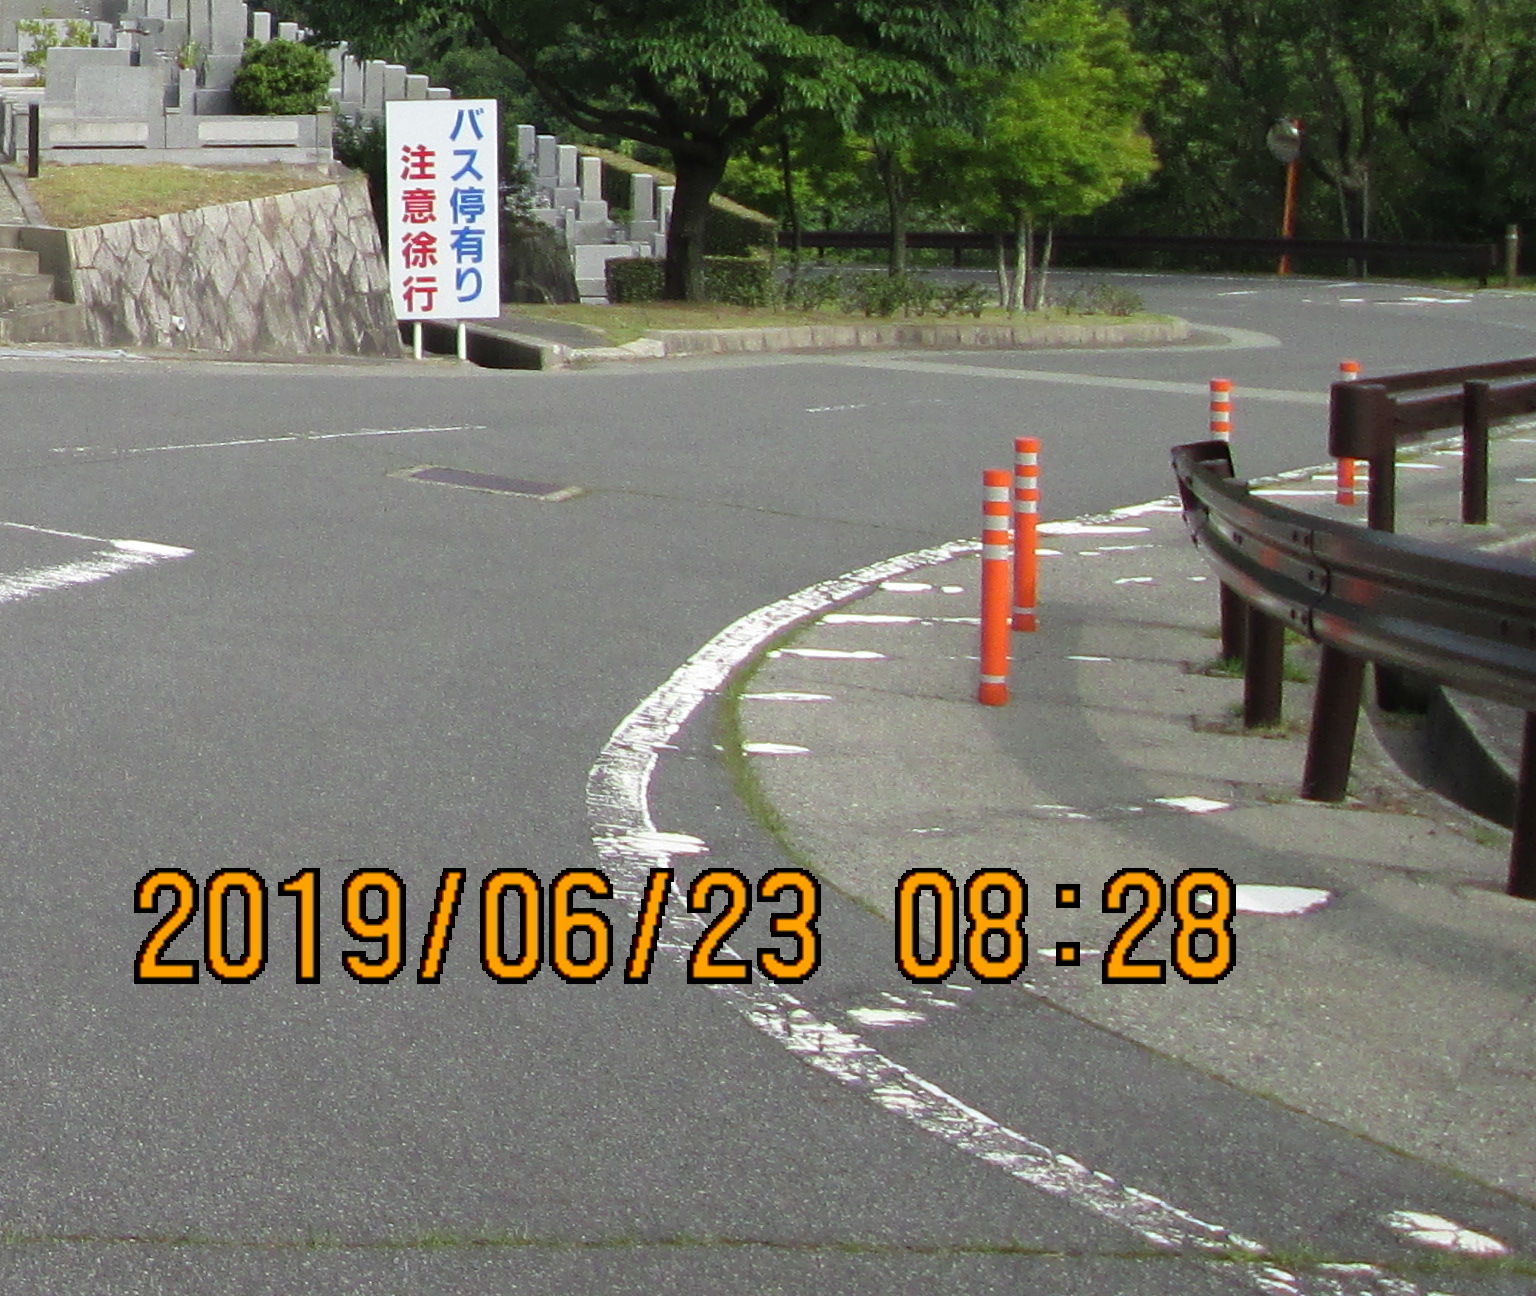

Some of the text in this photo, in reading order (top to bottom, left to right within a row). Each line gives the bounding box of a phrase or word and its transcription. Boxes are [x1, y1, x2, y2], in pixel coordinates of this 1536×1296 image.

[400, 144, 438, 312] 注意徐行
[449, 107, 486, 303] バス停有り
